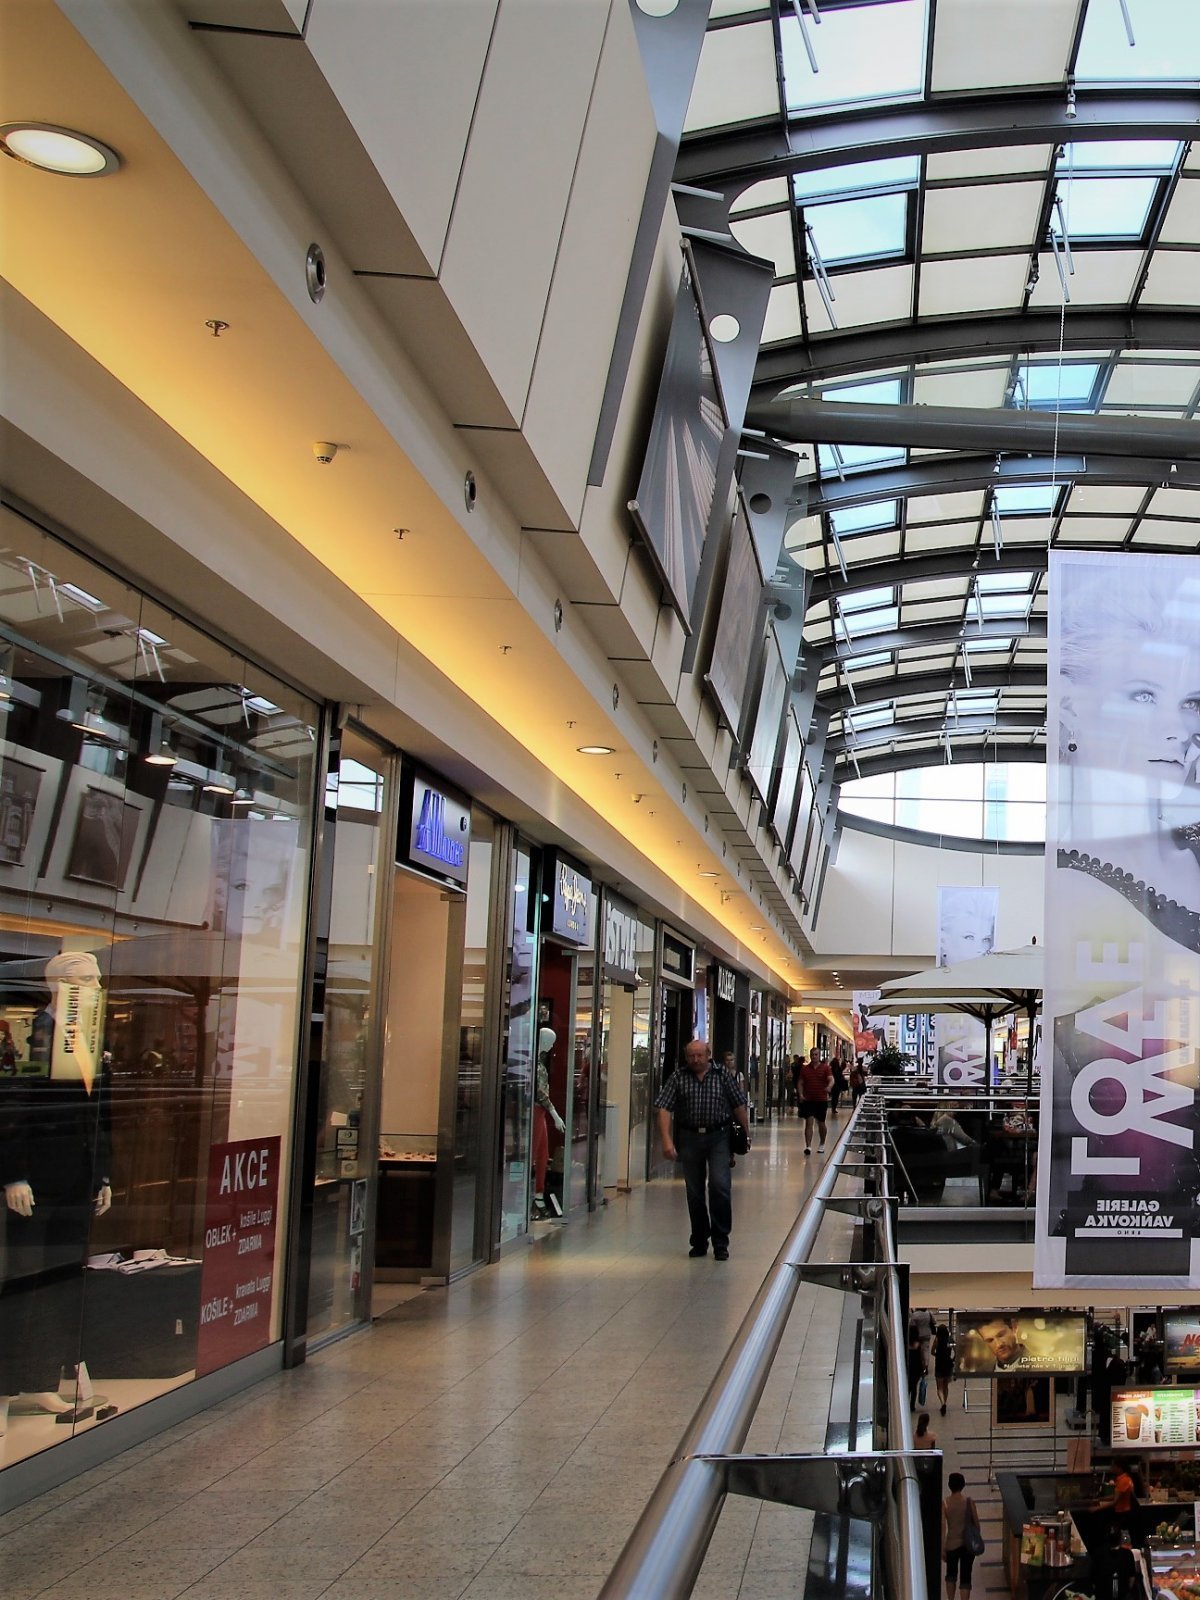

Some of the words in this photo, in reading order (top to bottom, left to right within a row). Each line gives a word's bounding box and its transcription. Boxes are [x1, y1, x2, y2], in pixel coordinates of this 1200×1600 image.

[219, 1149, 269, 1195] AKCE
[206, 1224, 231, 1249] OBLEK
[237, 1234, 262, 1255] ZDARMA
[201, 1297, 228, 1325] KOŠILE
[234, 1302, 259, 1326] ZDARMA
